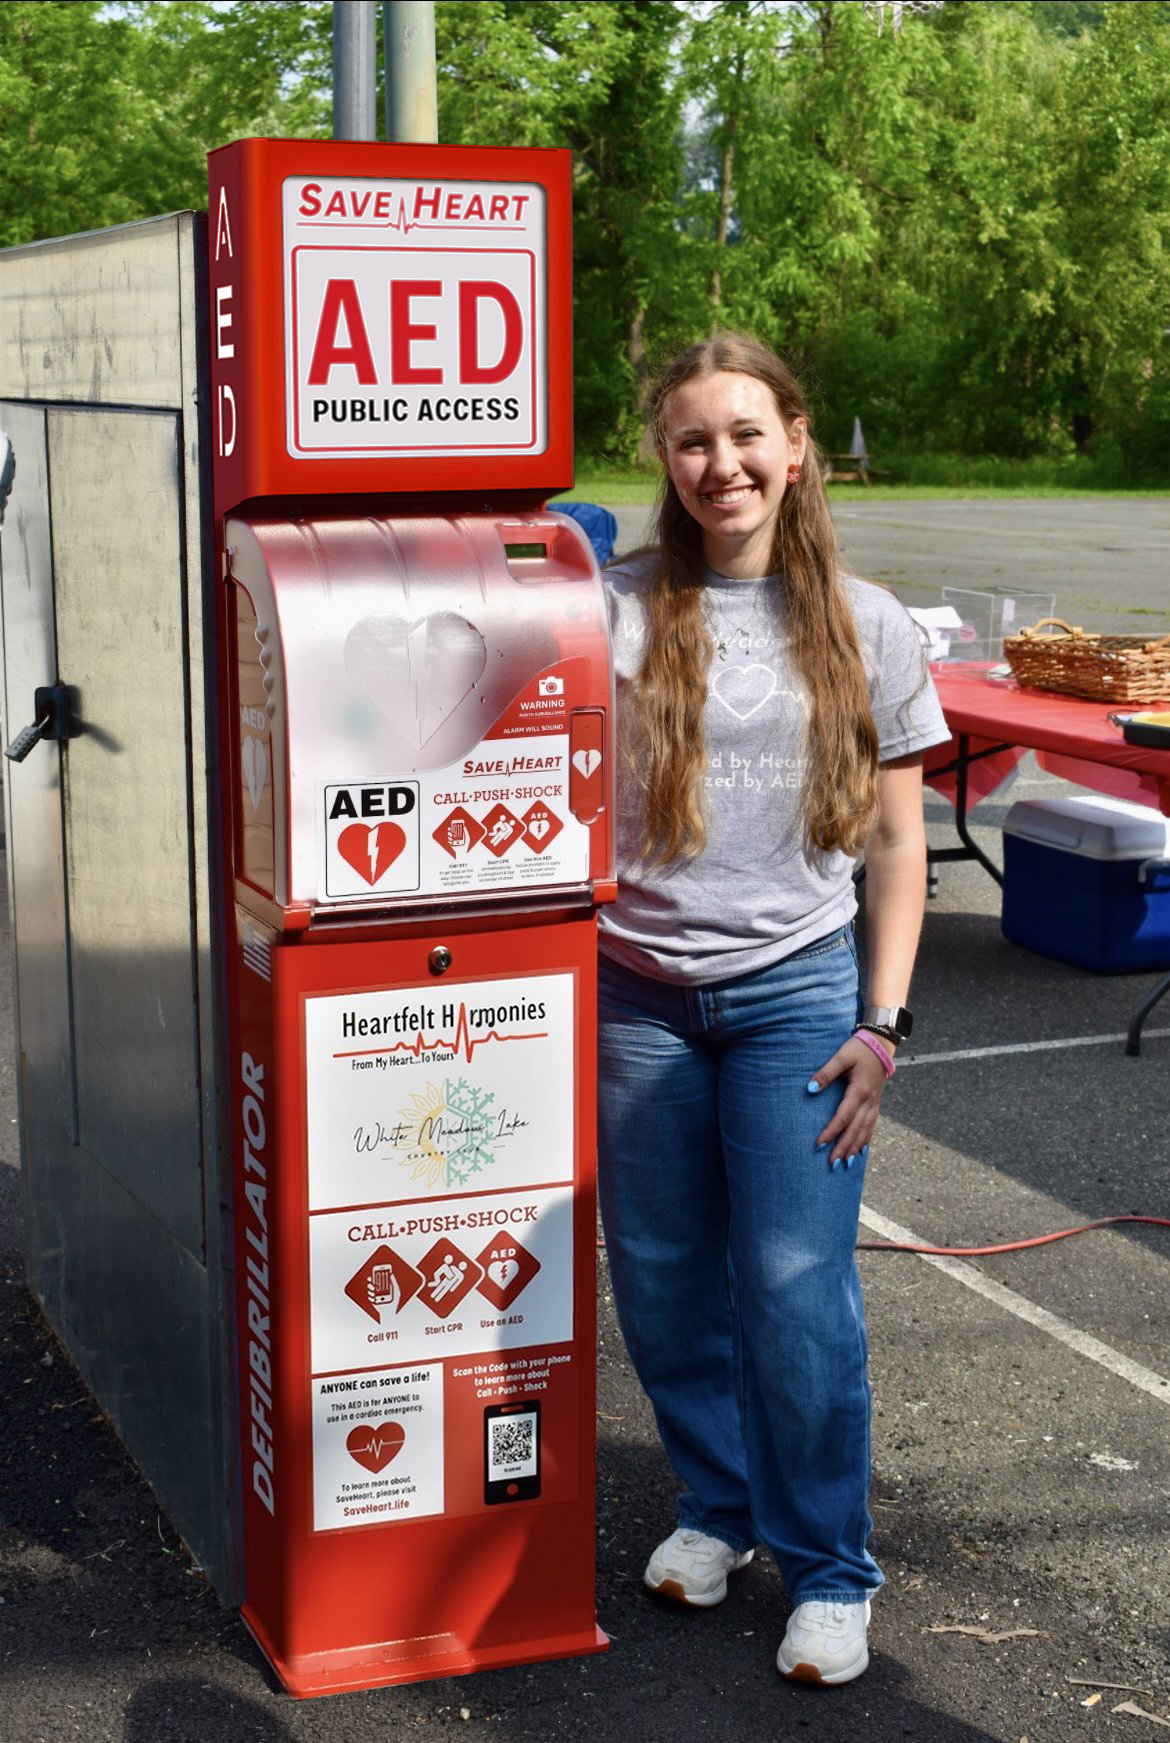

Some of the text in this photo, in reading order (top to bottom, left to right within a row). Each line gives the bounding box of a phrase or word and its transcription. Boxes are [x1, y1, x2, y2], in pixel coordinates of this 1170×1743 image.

[298, 183, 529, 221] SAVE HEART
[307, 279, 524, 386] AED
[313, 398, 520, 423] PUBLIC ACCESS
[520, 699, 565, 710] WARNING
[243, 704, 266, 730] AED
[463, 757, 562, 774] SAVE HEART
[730, 752, 753, 770] by
[744, 770, 764, 791] by
[329, 787, 416, 820] AED
[343, 1005, 435, 1038] Heartfelt
[352, 1059, 373, 1070] From
[375, 1057, 388, 1071] My
[431, 1052, 455, 1062] Yours
[354, 1109, 530, 1153] White Meadow Lake
[490, 1248, 516, 1260] AED
[242, 1050, 275, 1517] DEFIBRILLATOR
[376, 1271, 390, 1292] 911
[425, 1324, 463, 1335] Start CPR
[480, 1315, 524, 1328] Use an AED
[367, 1331, 398, 1343] Call 911
[452, 1355, 571, 1377] Scan the Code with your phone
[320, 1371, 430, 1394] ANYONE can save a life!
[474, 1368, 550, 1386] to learn more about
[477, 1380, 548, 1398] Call Push Shock
[331, 1393, 420, 1412] This AED is for ANYONE to
[341, 1413, 348, 1421] in
[355, 1409, 383, 1419] cardiac
[341, 1476, 412, 1492] To learn more about
[376, 1488, 400, 1499] please
[400, 1485, 417, 1494] visit
[343, 1499, 410, 1517] SaveHeart.life
